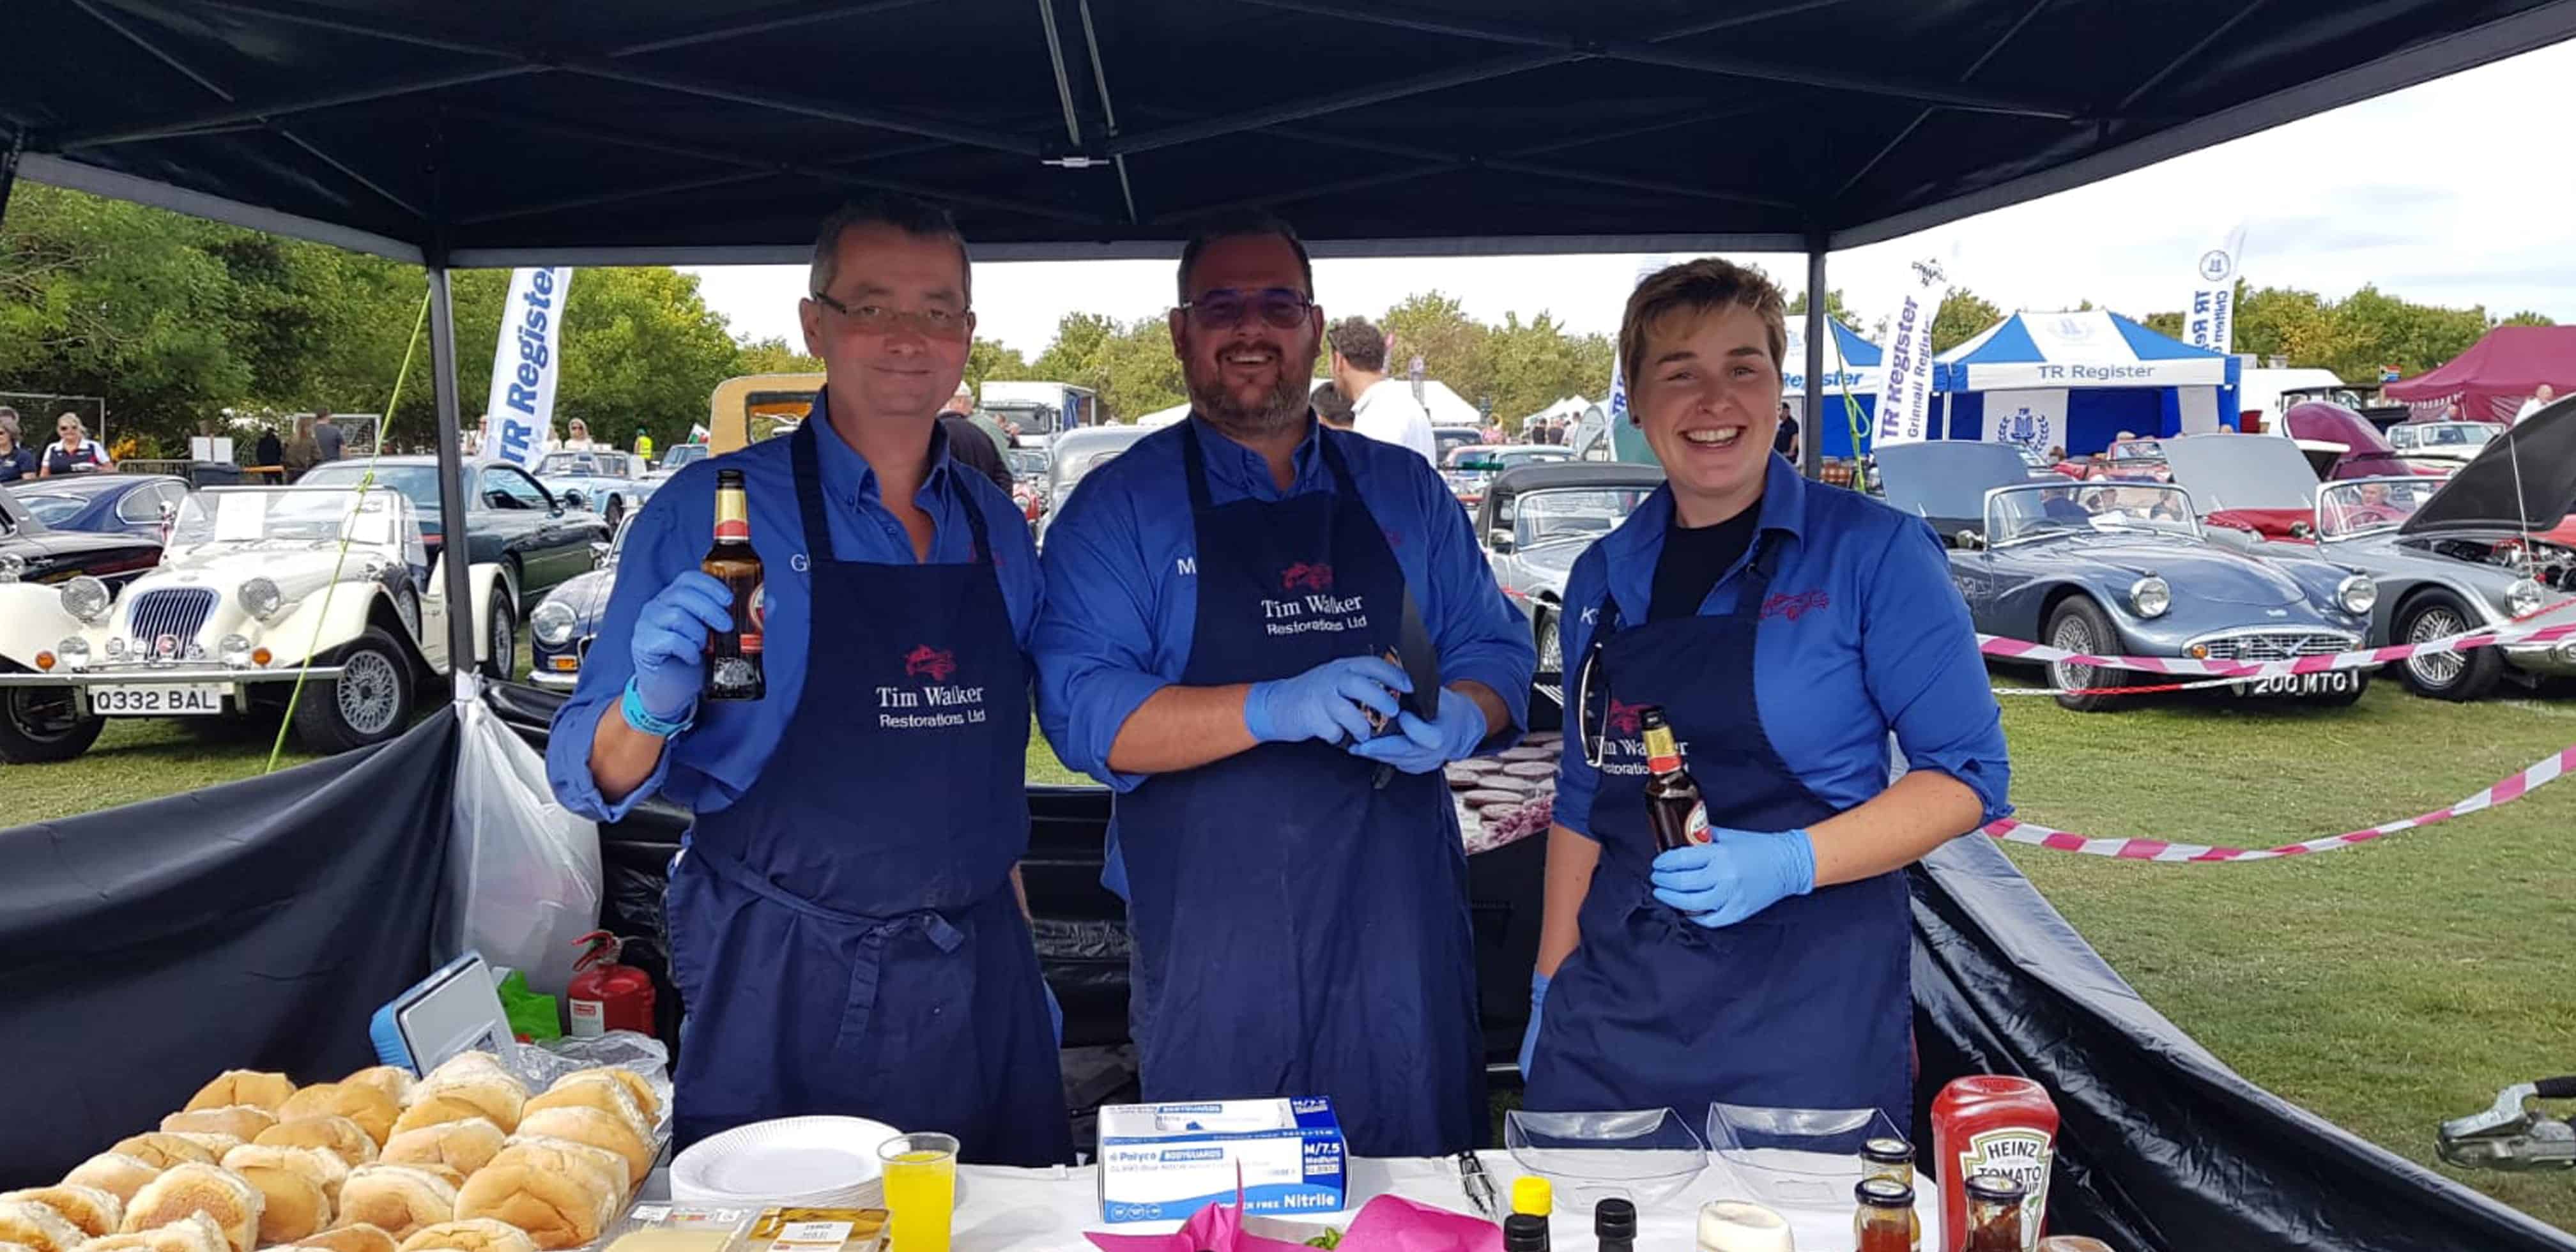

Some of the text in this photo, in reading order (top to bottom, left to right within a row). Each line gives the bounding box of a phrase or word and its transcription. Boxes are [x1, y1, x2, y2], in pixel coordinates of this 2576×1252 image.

[1880, 294, 1918, 438] TR Register
[2038, 364, 2155, 380] TR Register
[1783, 370, 1864, 387] Rester
[500, 420, 532, 464] TR
[1261, 595, 1362, 618] Tim Walker
[1347, 615, 1367, 629] Ltd
[168, 691, 217, 710] BAL
[876, 685, 984, 707] Tim Walker
[880, 708, 986, 728] Restorations Ltd
[1304, 1143, 1340, 1156] M/7.5
[1988, 1141, 2038, 1159] HEINZ
[1284, 1193, 1336, 1208] Nitrile
